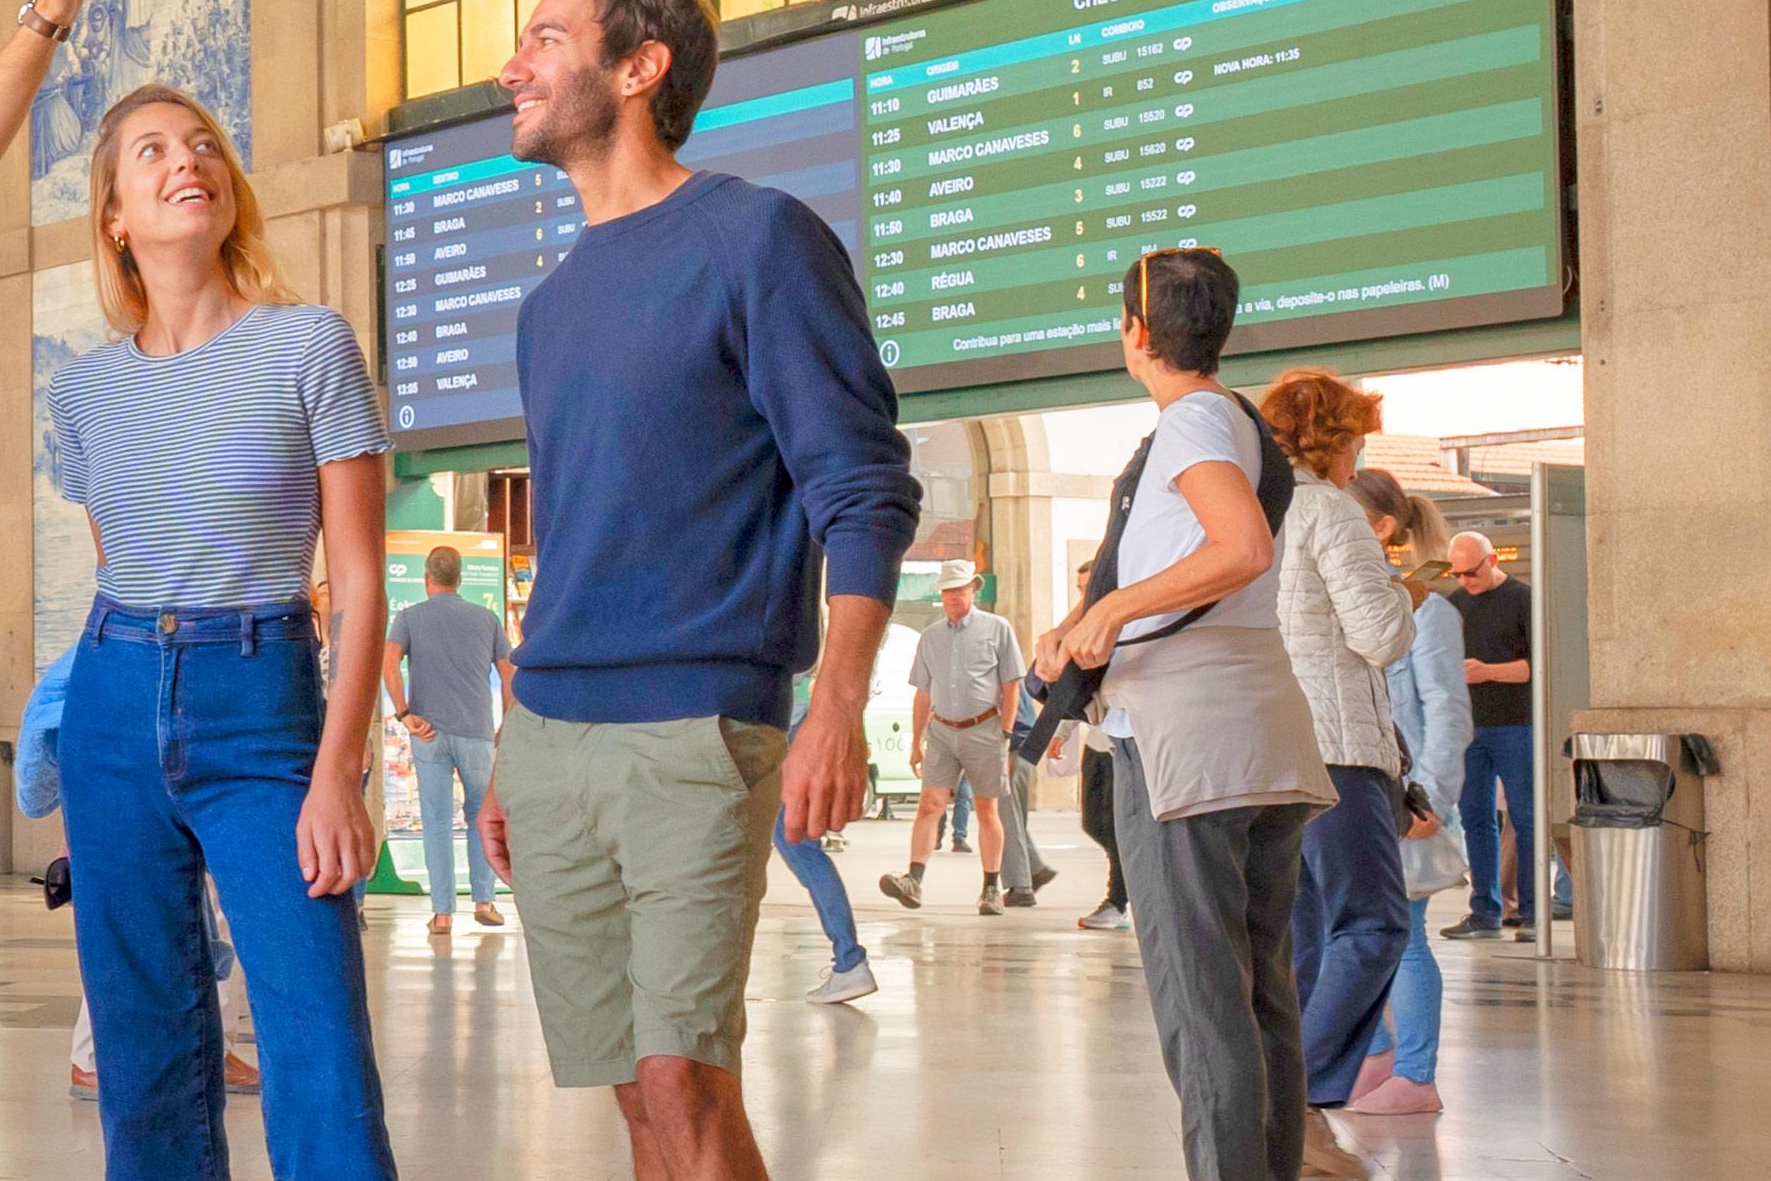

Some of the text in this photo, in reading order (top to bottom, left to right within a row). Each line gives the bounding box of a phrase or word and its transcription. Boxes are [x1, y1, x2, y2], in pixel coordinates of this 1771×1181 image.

[871, 97, 900, 115] 11:10
[927, 76, 999, 104] GUIMARÃES
[1071, 60, 1079, 73] 2
[1102, 50, 1127, 65] SUBU
[872, 128, 901, 146] 11:25
[927, 111, 984, 135] VALENÇA
[1073, 92, 1080, 105] 1
[1103, 86, 1113, 97] IR
[1214, 60, 1241, 76] NOVA
[1242, 54, 1274, 70] HORA:
[1275, 47, 1300, 63] 11:35
[873, 158, 901, 176] 11:30
[928, 145, 973, 166] MARCO
[975, 130, 1050, 157] CANAVESES
[1073, 124, 1081, 138] 6
[1104, 116, 1129, 130] SUBU
[433, 191, 465, 207] MARCO
[467, 179, 519, 200] CANAVESES
[535, 174, 541, 186] 5
[873, 189, 902, 207] 11:40
[929, 176, 974, 197] AVEIRO
[1073, 156, 1082, 170] 4
[1104, 149, 1130, 163] SUBU
[434, 218, 465, 234] BRAGA
[535, 201, 542, 213] 2
[930, 208, 974, 228] BRAGA
[1075, 189, 1083, 203] 3
[1105, 182, 1130, 196] SUBU
[434, 244, 467, 259] AVEIRO
[536, 229, 543, 240] 6
[874, 250, 904, 268] 12:30
[931, 239, 975, 259] MARCO
[977, 226, 1052, 251] CANAVESES
[1076, 221, 1083, 235] 5
[1106, 214, 1131, 229] SUBU
[435, 266, 486, 286] GUIMARÃES
[536, 256, 543, 267] 4
[875, 281, 905, 298] 12:40
[931, 271, 975, 290] RÉGUA
[1077, 254, 1084, 267] 6
[1107, 250, 1117, 261] IR
[435, 296, 467, 311] MARCO
[468, 286, 521, 306] CANAVESES
[876, 312, 905, 328] 12:45
[932, 302, 976, 321] BRAGA
[1077, 286, 1085, 300] 4
[1255, 298, 1275, 313] via,
[1277, 288, 1335, 309] deposite-o
[1337, 288, 1359, 301] nas
[1361, 276, 1425, 300] papeleiras.
[1428, 274, 1450, 291] (M)
[436, 322, 467, 338] BRAGA
[953, 333, 997, 351] Contribua
[999, 333, 1022, 347] para
[1023, 330, 1045, 342] uma
[1046, 323, 1086, 339] estação
[1087, 320, 1111, 333] mais
[436, 348, 469, 364] AVEIRO
[436, 374, 478, 390] VALENÇA
